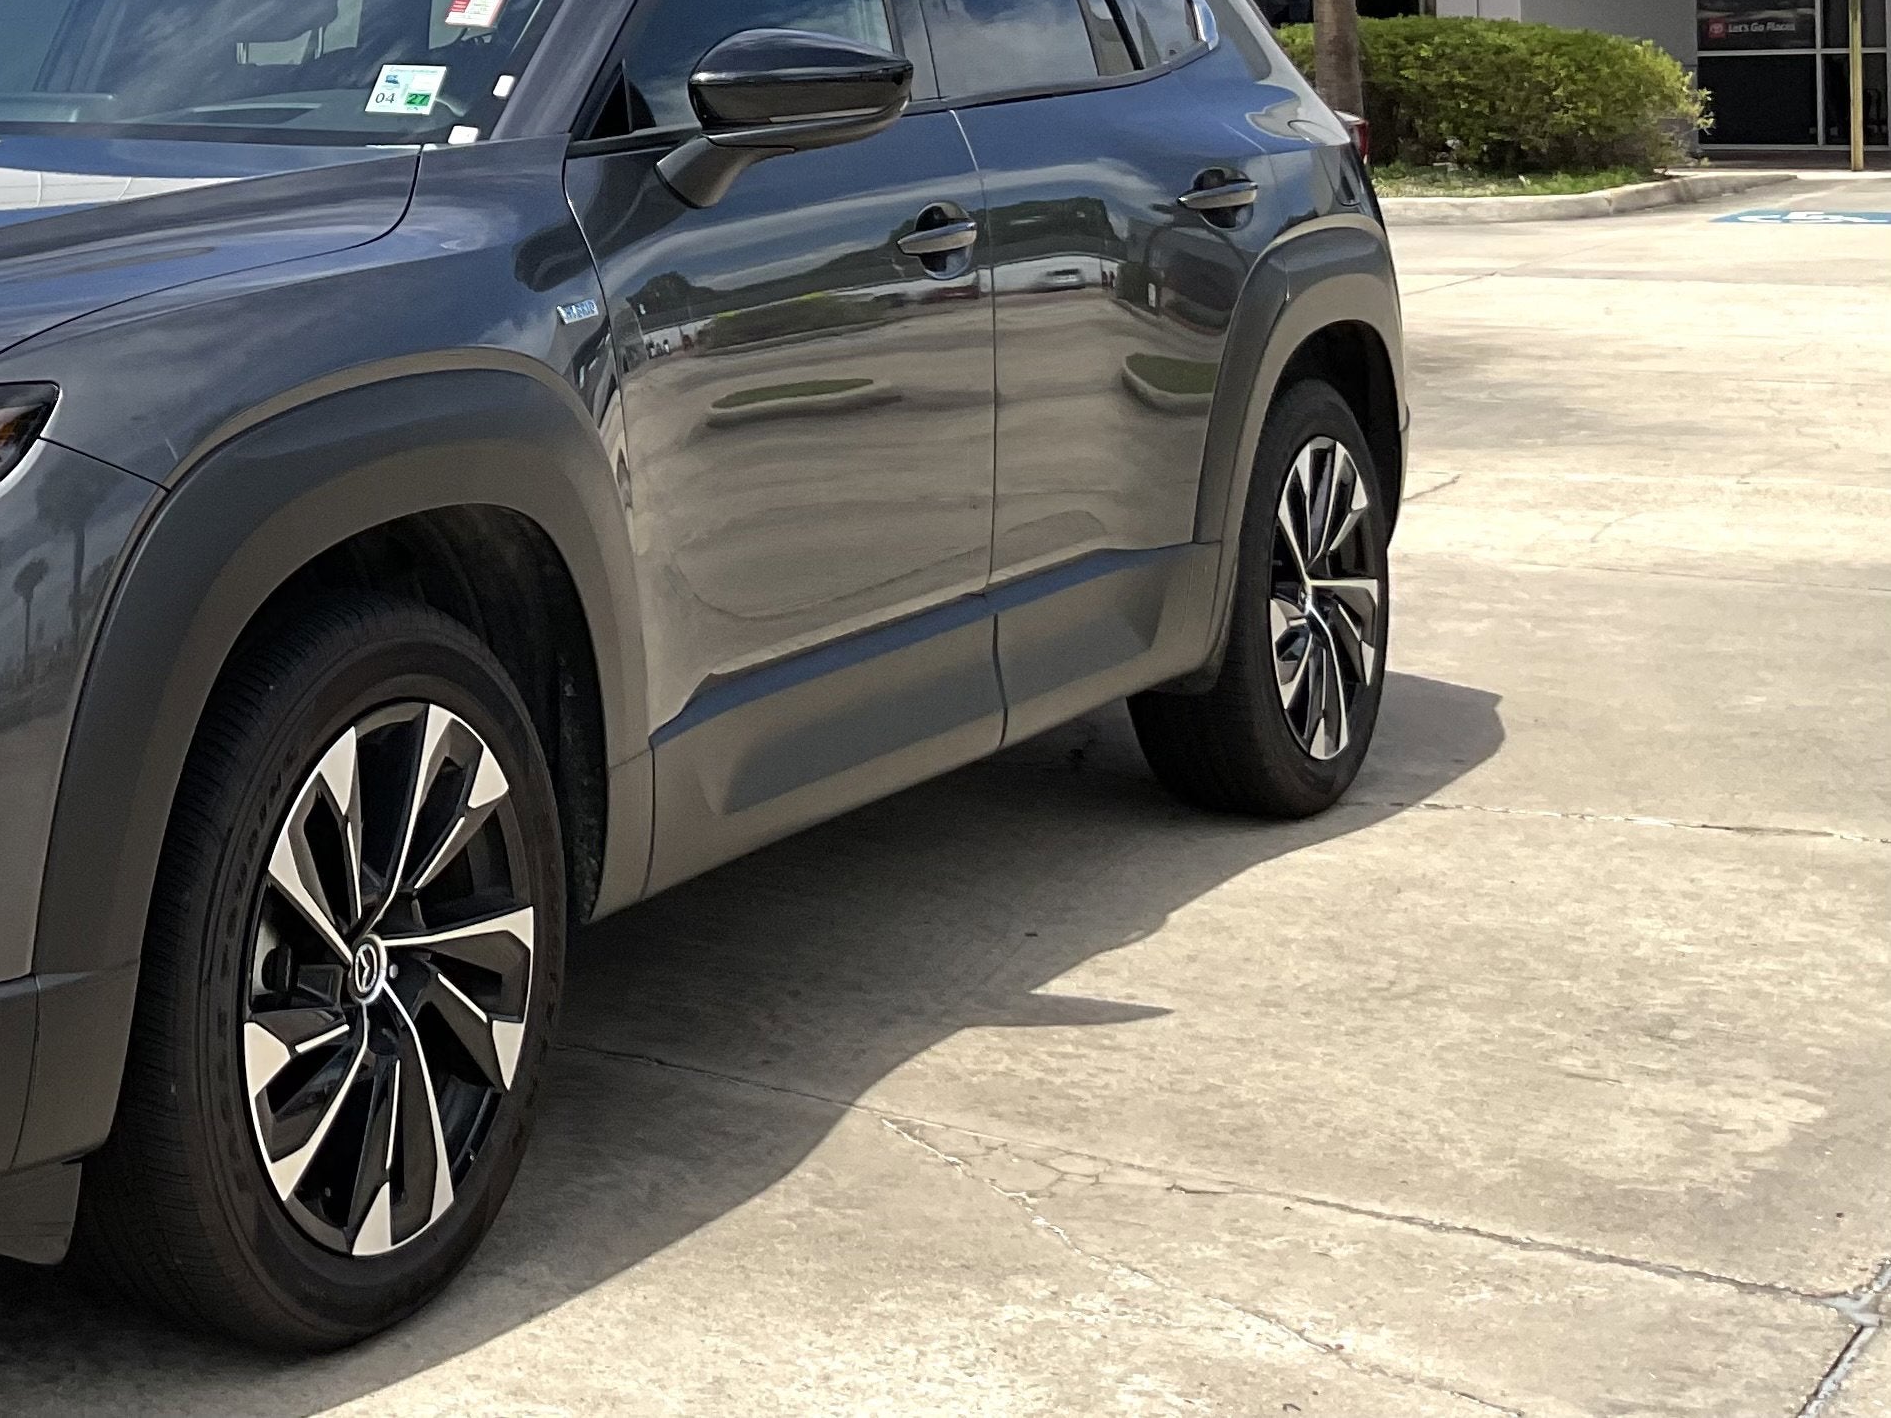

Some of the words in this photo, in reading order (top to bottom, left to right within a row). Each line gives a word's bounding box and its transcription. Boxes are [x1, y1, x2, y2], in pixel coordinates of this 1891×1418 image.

[1750, 22, 1765, 32] Go
[375, 92, 396, 104] 04
[406, 93, 430, 105] 27
